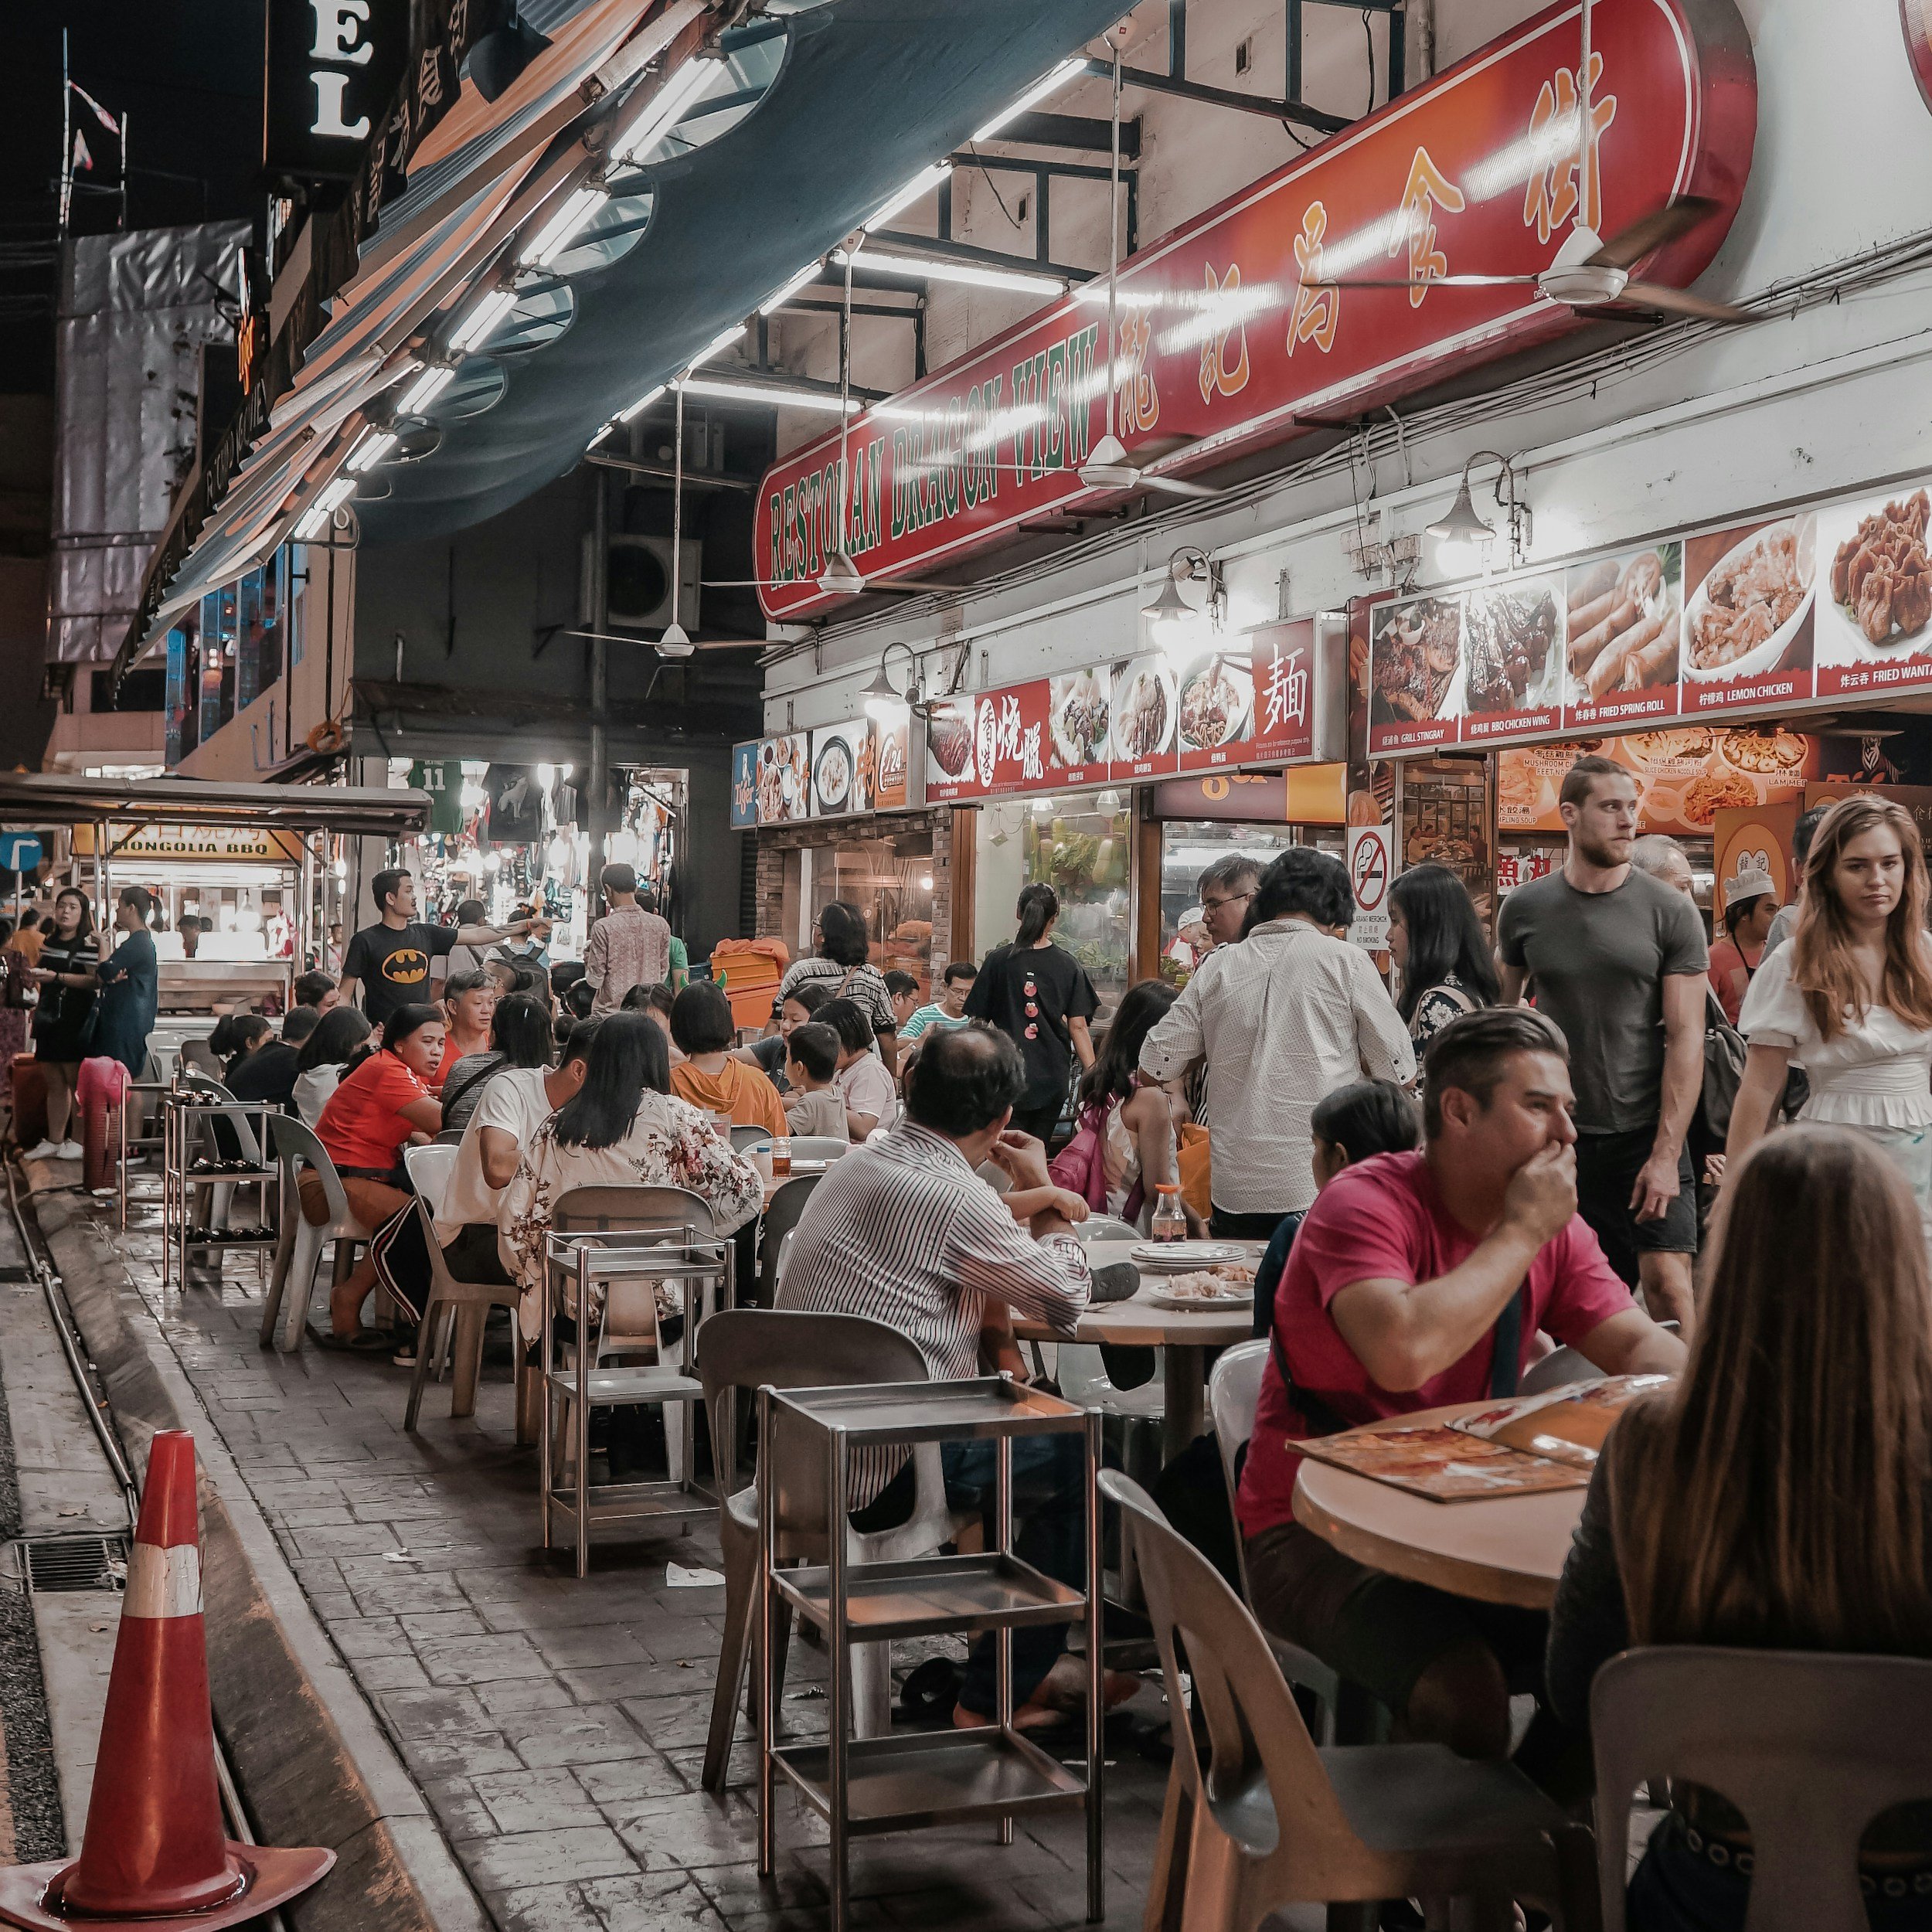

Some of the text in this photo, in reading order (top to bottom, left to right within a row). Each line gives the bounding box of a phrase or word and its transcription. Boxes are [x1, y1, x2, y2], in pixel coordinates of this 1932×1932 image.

[770, 321, 1099, 592] RESTORAN DRAGON VIEW
[1872, 668, 1900, 683] FRIED
[1726, 682, 1793, 702] LEMON CHICKEN
[1599, 699, 1665, 718] FRIED SPRING ROLL
[1491, 714, 1550, 733] BBQ CHICKEN WING
[1401, 729, 1445, 743] GRILL STINGRAY
[423, 767, 446, 791] 11
[735, 781, 754, 815] Tiger
[112, 841, 268, 855] MONGOLIA BBQ
